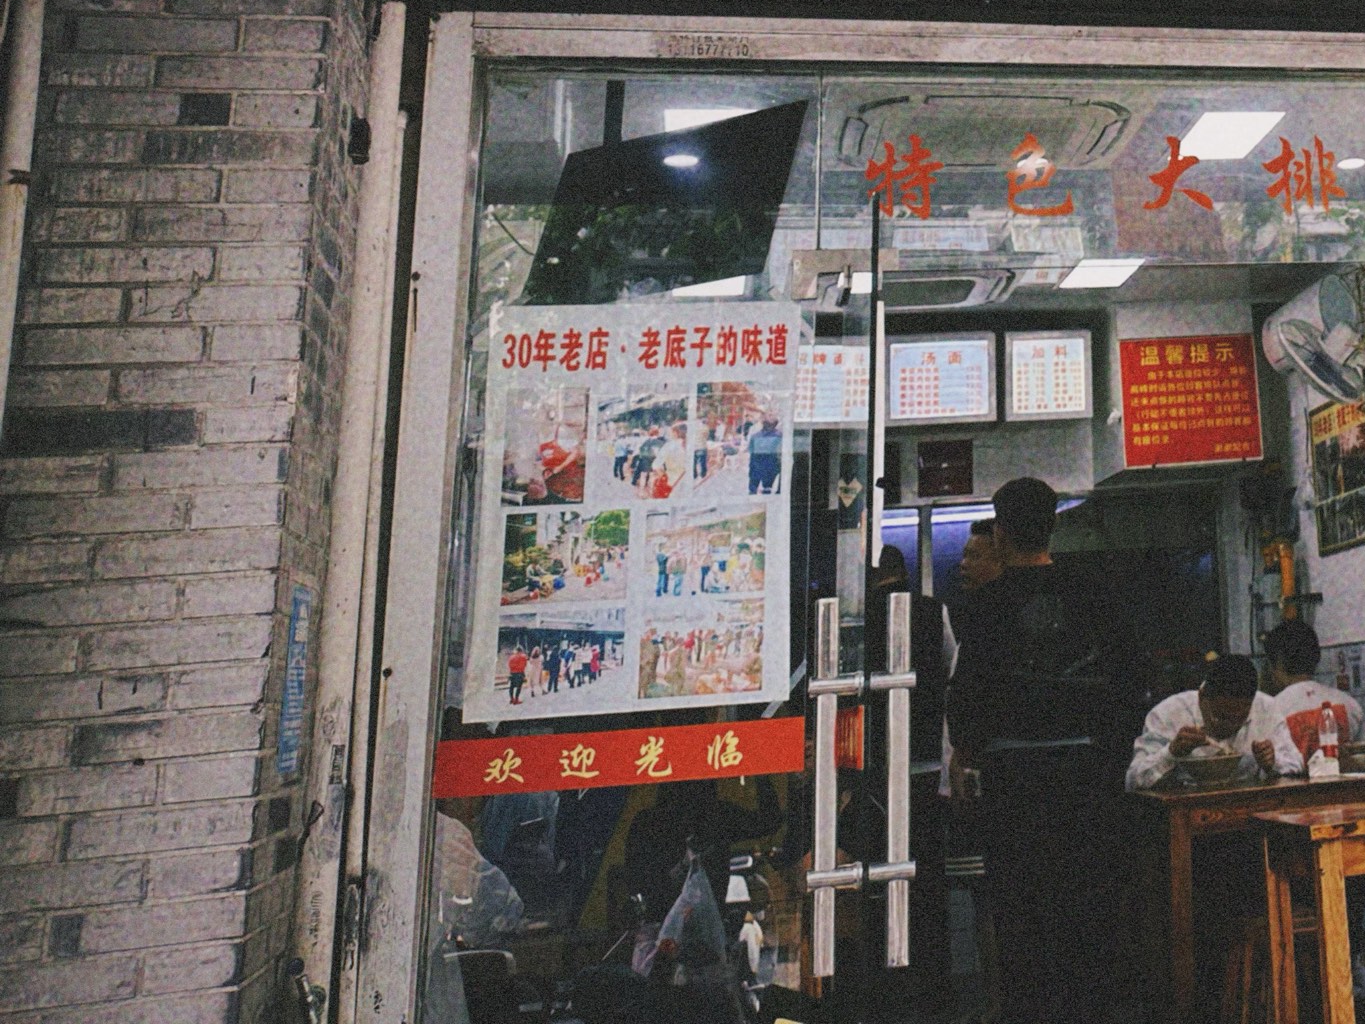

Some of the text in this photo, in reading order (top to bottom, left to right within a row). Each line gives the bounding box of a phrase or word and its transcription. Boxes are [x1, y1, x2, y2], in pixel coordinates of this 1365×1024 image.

[502, 323, 788, 372] 30年老店·老底子的味道
[1141, 342, 1234, 366] 温馨提示
[483, 730, 744, 783] 欢迎光临
